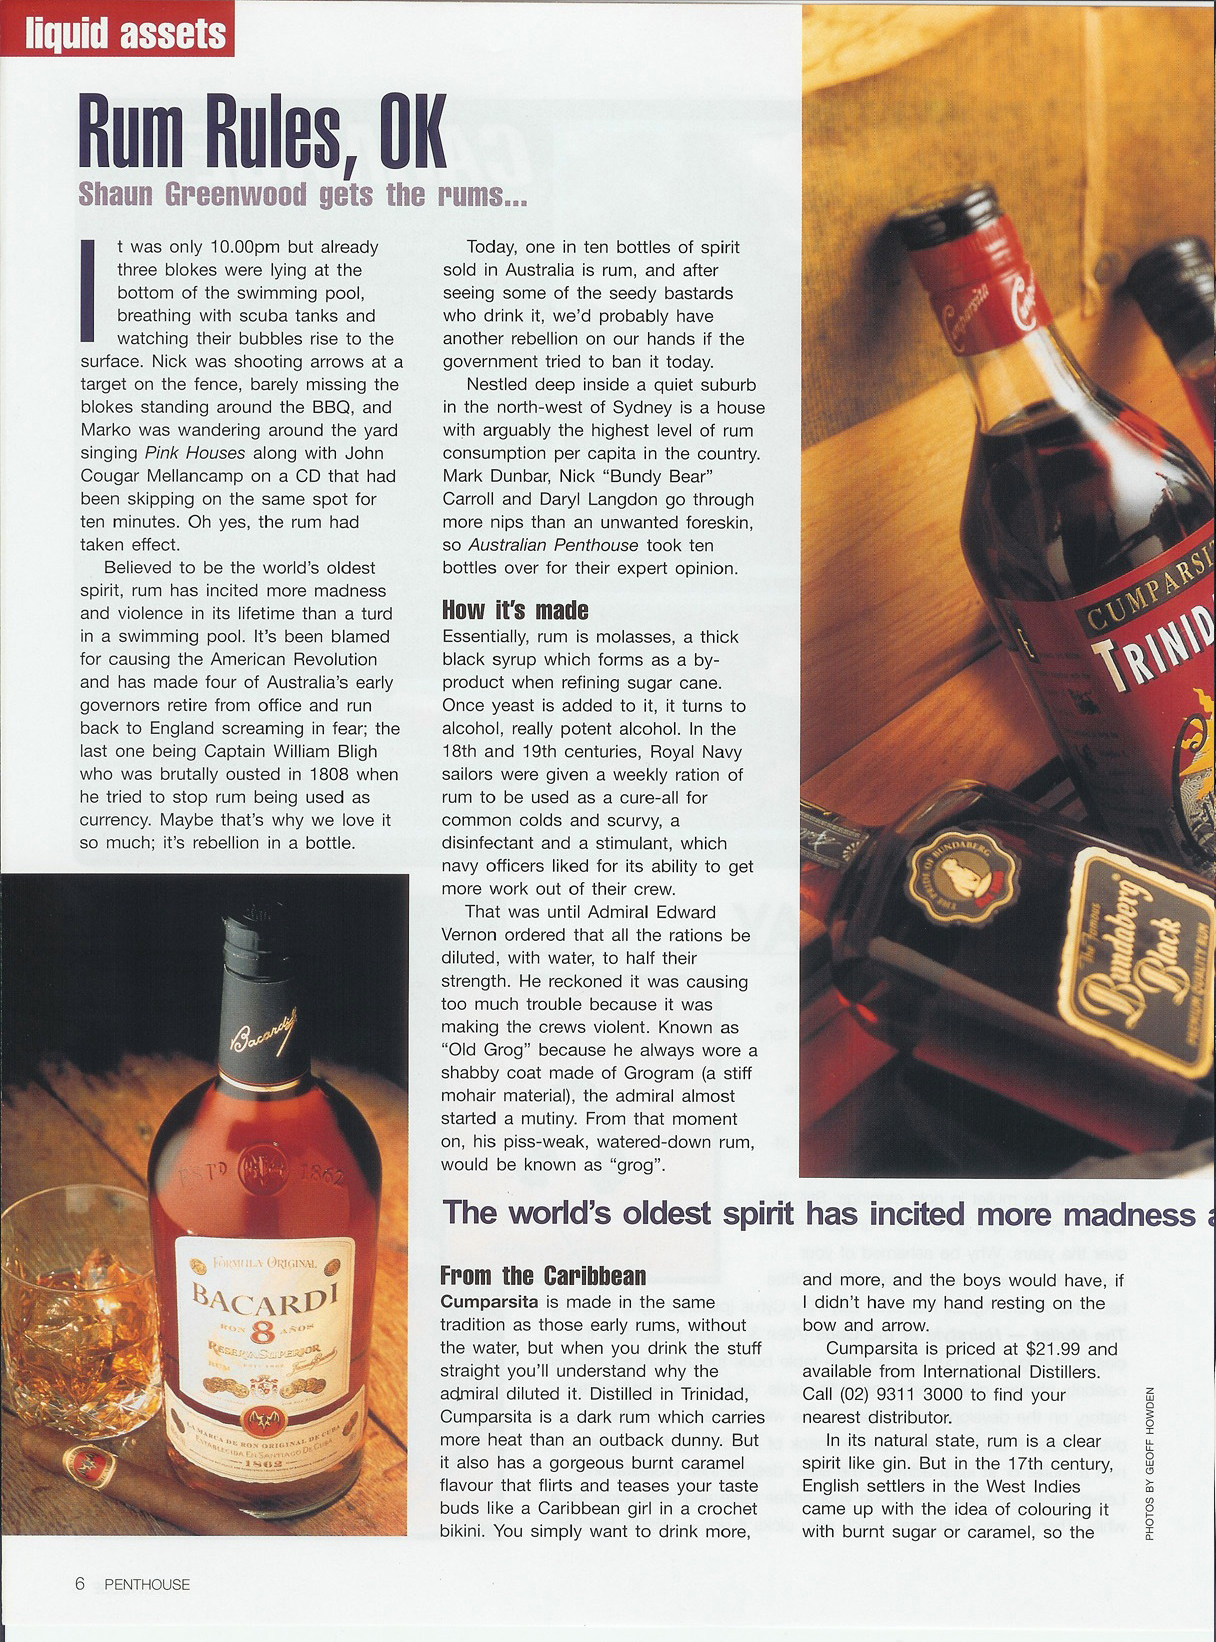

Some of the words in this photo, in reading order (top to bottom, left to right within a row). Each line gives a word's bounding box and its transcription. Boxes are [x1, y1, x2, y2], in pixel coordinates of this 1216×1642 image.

[26, 17, 108, 54] liquid
[120, 18, 227, 49] assets
[79, 93, 183, 168] Rum
[207, 93, 357, 181] Rules,
[381, 93, 447, 169] OK
[79, 181, 152, 206] Shaun
[166, 182, 307, 206] Greenwood
[320, 183, 373, 210] gets
[386, 182, 425, 206] the
[437, 182, 528, 207] rums...
[81, 400, 132, 413] blokes
[141, 400, 208, 416] standing
[217, 400, 271, 413] around
[280, 400, 304, 413] the
[313, 400, 353, 415] BBQ,
[363, 400, 391, 413] and
[444, 469, 482, 482] Mark
[491, 469, 550, 484] Dunbar,
[560, 469, 595, 482] Nick
[603, 469, 661, 486] “Bundy
[670, 469, 712, 483] Bear”
[443, 599, 485, 619] How
[496, 600, 525, 619] it’s
[536, 600, 588, 620] made
[80, 767, 112, 780] who
[121, 770, 152, 780] was
[161, 767, 218, 784] brutally
[226, 767, 280, 780] ousted
[289, 767, 301, 780] in
[311, 767, 348, 780] 1808
[357, 767, 398, 780] when
[931, 841, 992, 858] BUNDABERG
[1078, 879, 1154, 1030] Bundaberg
[1133, 917, 1191, 1007] Black
[443, 1199, 497, 1224] The
[508, 1200, 611, 1224] world’s
[623, 1200, 711, 1224] oldest
[723, 1200, 794, 1231] spirit
[807, 1201, 857, 1225] has
[871, 1201, 964, 1225] incited
[978, 1208, 1051, 1226] more
[1065, 1202, 1195, 1226] madness
[267, 1256, 318, 1270] ORIGINAL
[441, 1265, 491, 1285] From
[502, 1265, 533, 1285] the
[544, 1265, 646, 1285] Caribbean
[192, 1281, 339, 1317] BACARDI
[220, 1323, 246, 1334] RON
[250, 1320, 276, 1345] 8
[279, 1323, 315, 1335] AÑOS
[803, 1387, 831, 1400] Call
[841, 1387, 868, 1403] (02)
[877, 1387, 912, 1400] 9311
[924, 1387, 962, 1401] 3000
[971, 1388, 985, 1401] to
[994, 1388, 1022, 1401] find
[1031, 1391, 1066, 1404] your
[1145, 1387, 1155, 1435] HOWDEN
[197, 1427, 224, 1443] MARCA
[261, 1439, 307, 1449] ORIGINAL
[245, 1460, 283, 1468] 1862
[1145, 1439, 1155, 1475] GEOFF
[1145, 1479, 1155, 1493] BY
[1145, 1497, 1155, 1541] PHOTOS
[75, 1577, 85, 1590] 6
[105, 1579, 190, 1590] PENTHOUSE
